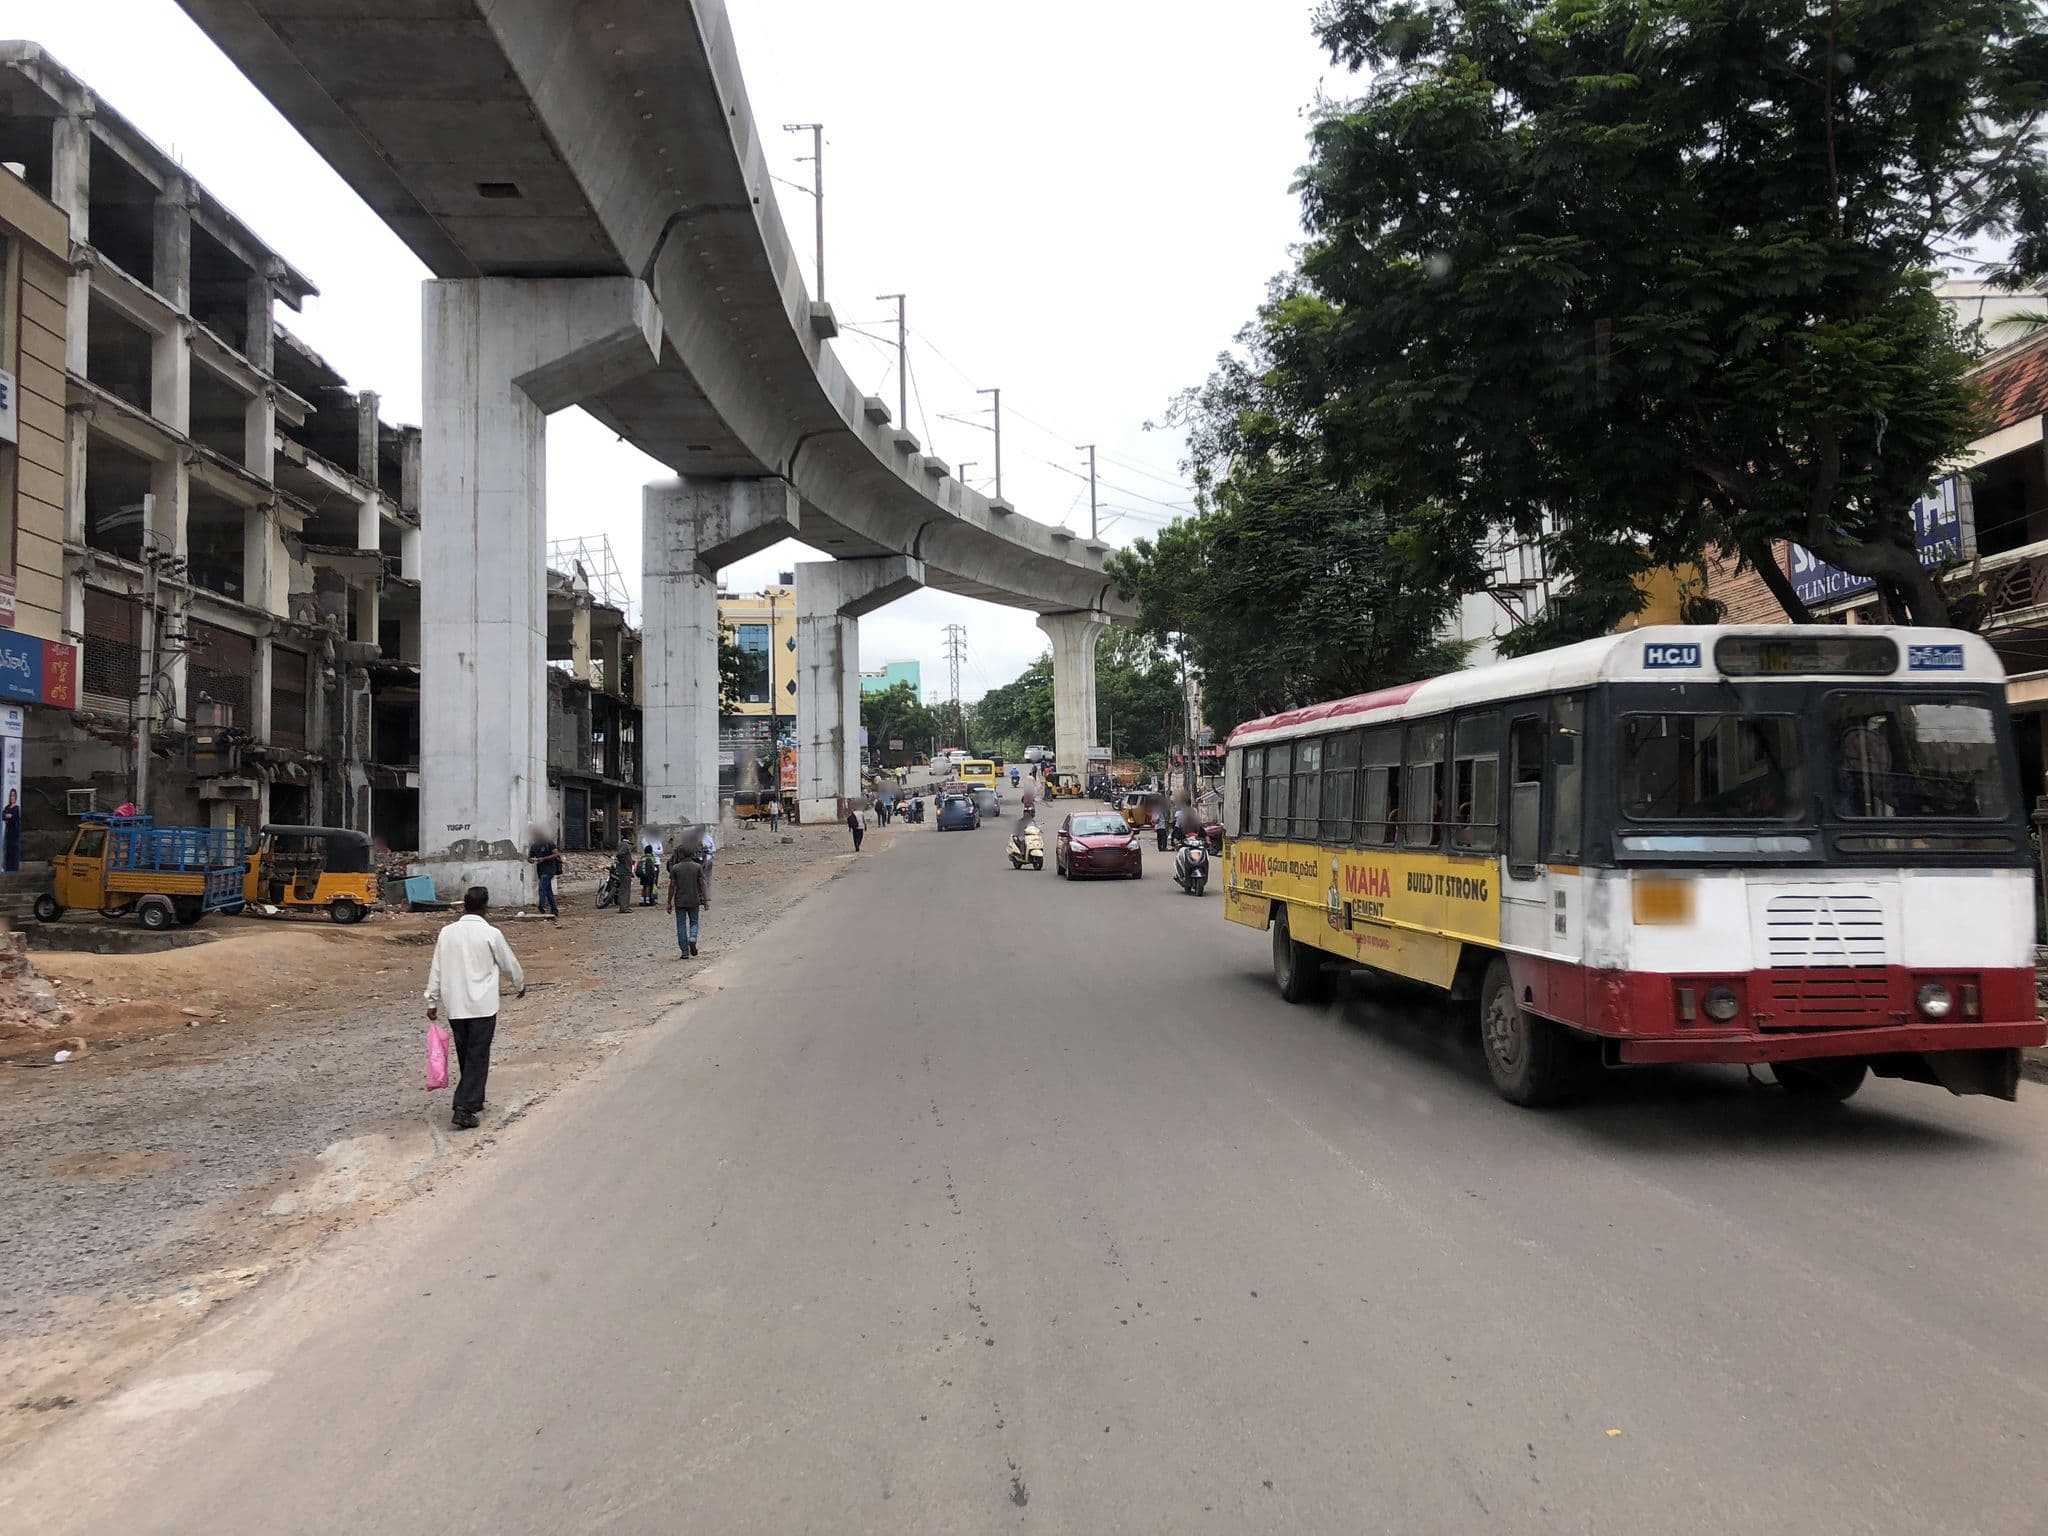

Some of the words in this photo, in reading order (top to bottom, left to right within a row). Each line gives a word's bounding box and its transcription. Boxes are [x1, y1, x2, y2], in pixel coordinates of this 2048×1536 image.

[1796, 574, 1841, 601] CLINIC
[1648, 649, 1696, 664] H.C.U
[1240, 852, 1267, 876] MAHA
[1244, 878, 1263, 892] CEMENT
[1345, 865, 1391, 898] MAHA
[1407, 871, 1432, 894] BUILD
[1435, 874, 1444, 896] IT
[1445, 875, 1488, 902] STRONG
[1352, 898, 1385, 917] CEMENT
